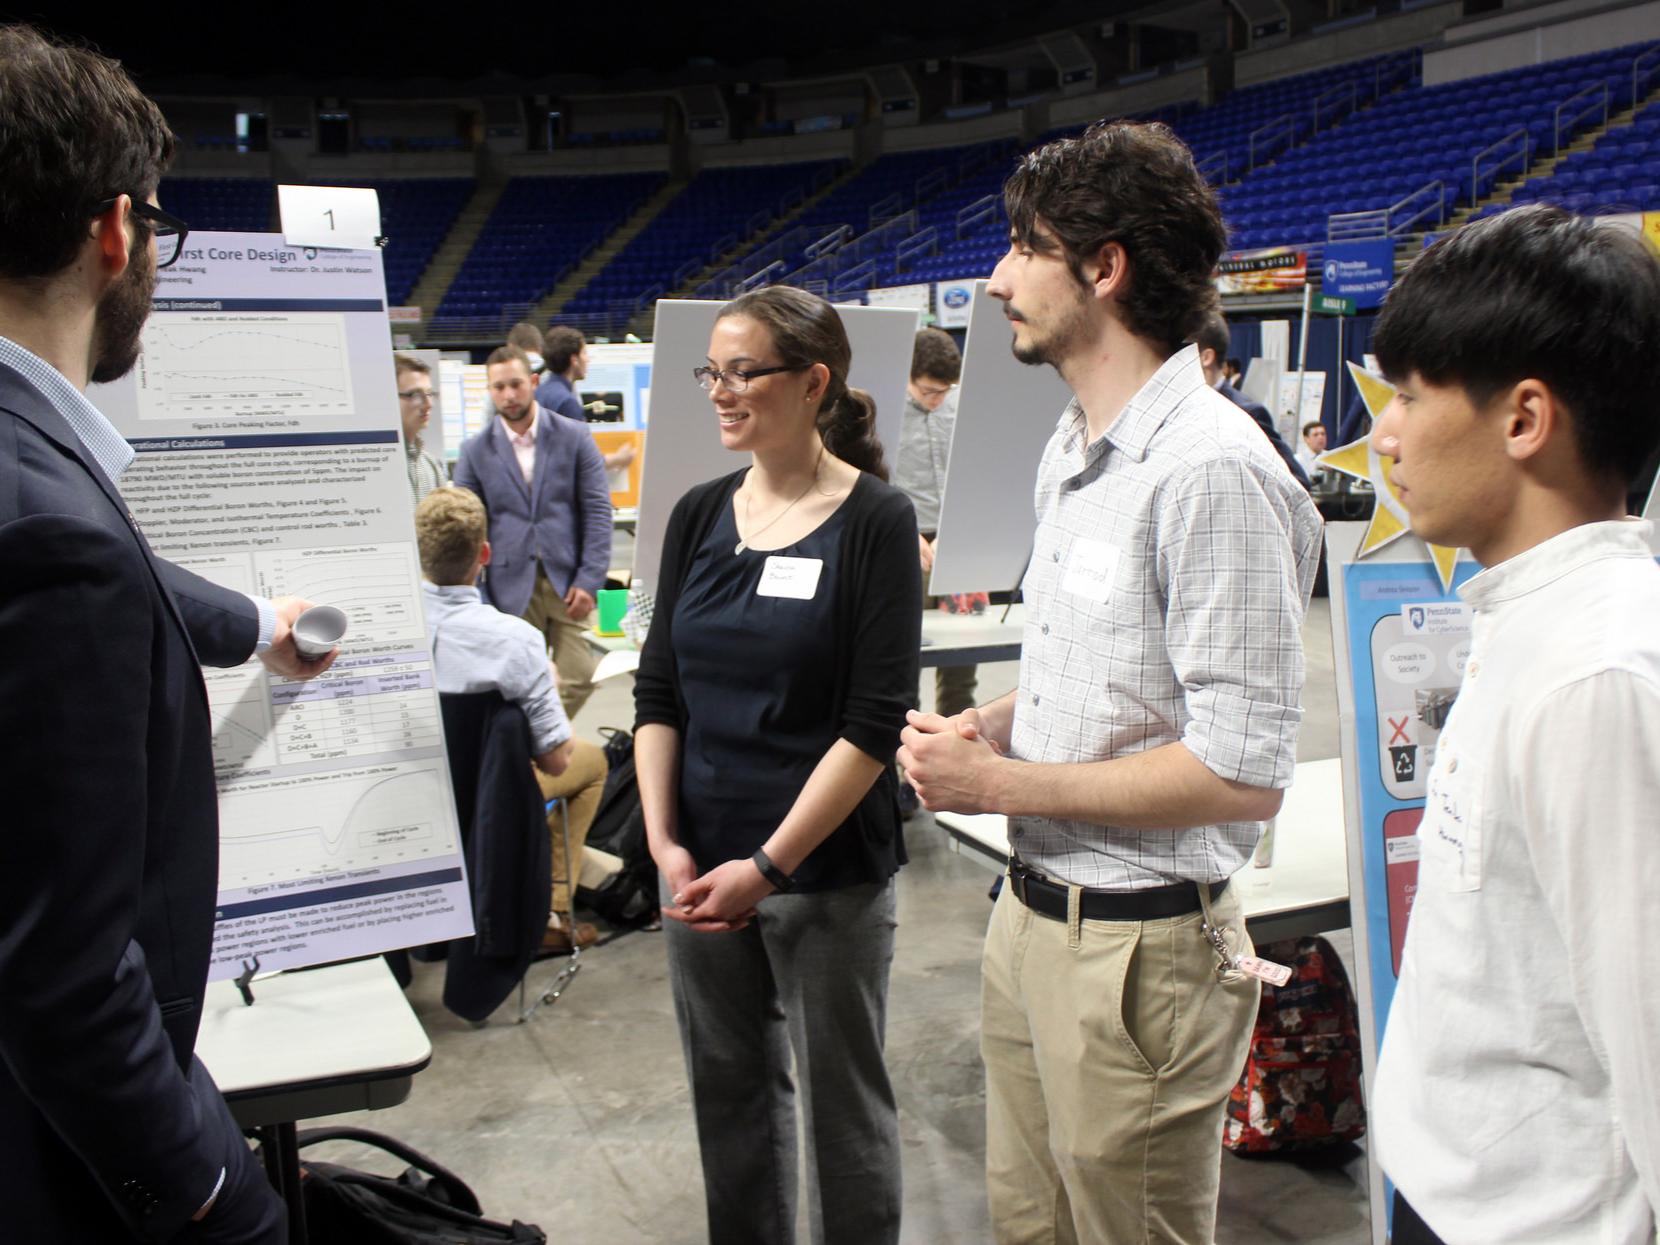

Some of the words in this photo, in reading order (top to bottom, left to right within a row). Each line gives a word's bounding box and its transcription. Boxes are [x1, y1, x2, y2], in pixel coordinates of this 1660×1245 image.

[324, 209, 335, 231] 1
[180, 248, 204, 260] irst
[208, 248, 243, 260] Core
[247, 248, 297, 264] Design
[1259, 256, 1296, 267] MOTORS
[171, 301, 222, 310] (continued)
[172, 439, 224, 448] Calculations
[1427, 607, 1461, 616] PennState
[1390, 653, 1418, 661] Outreach
[1398, 665, 1420, 673] Society
